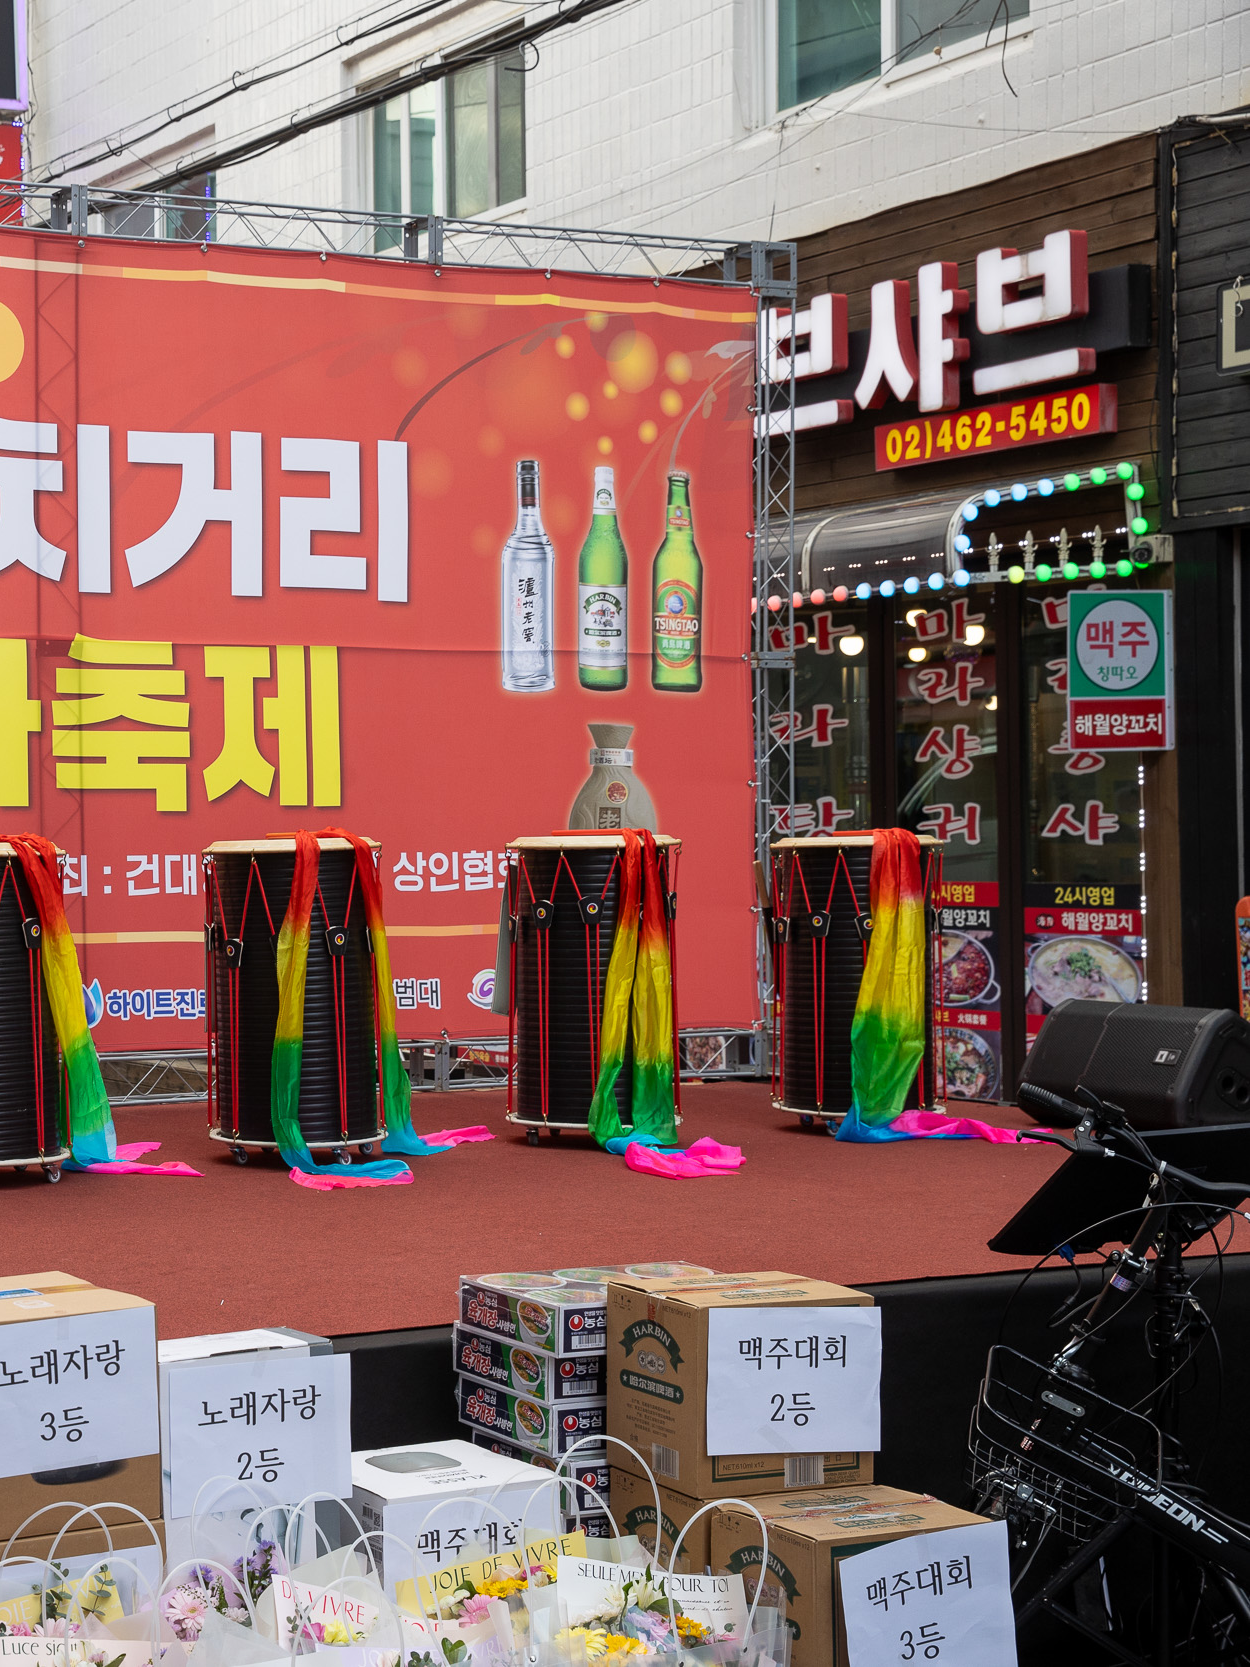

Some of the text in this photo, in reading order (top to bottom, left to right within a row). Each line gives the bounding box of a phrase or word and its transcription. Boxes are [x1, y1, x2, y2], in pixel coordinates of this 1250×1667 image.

[753, 229, 1096, 438] 브샤브
[885, 392, 1091, 463] 02)462-5450
[655, 618, 698, 632] TSINGTAO
[1086, 620, 1150, 658] 맥주
[1097, 665, 1139, 681] 칭따오
[1075, 713, 1163, 737] 해월양꼬치
[125, 854, 212, 896] 건대
[1054, 887, 1114, 905] 24시영업
[1061, 912, 1132, 932] 해월양꼬치
[468, 1300, 498, 1328] 육개장
[584, 1317, 607, 1328] 농심
[633, 1324, 671, 1347] HARBIN
[461, 1346, 491, 1375] 육개장
[739, 1335, 848, 1371] 맥주대회
[575, 1362, 599, 1374] 농심
[198, 1384, 322, 1427] 노래자랑
[466, 1396, 496, 1426] 육개장
[770, 1393, 817, 1427] 2등
[40, 1406, 90, 1443] 3등
[579, 1416, 602, 1429] 농심
[237, 1448, 285, 1483] 2등
[430, 1567, 471, 1593] JOIE
[865, 1555, 973, 1612] 맥주대회
[2, 1639, 39, 1656] Luce
[899, 1622, 946, 1661] 3등
